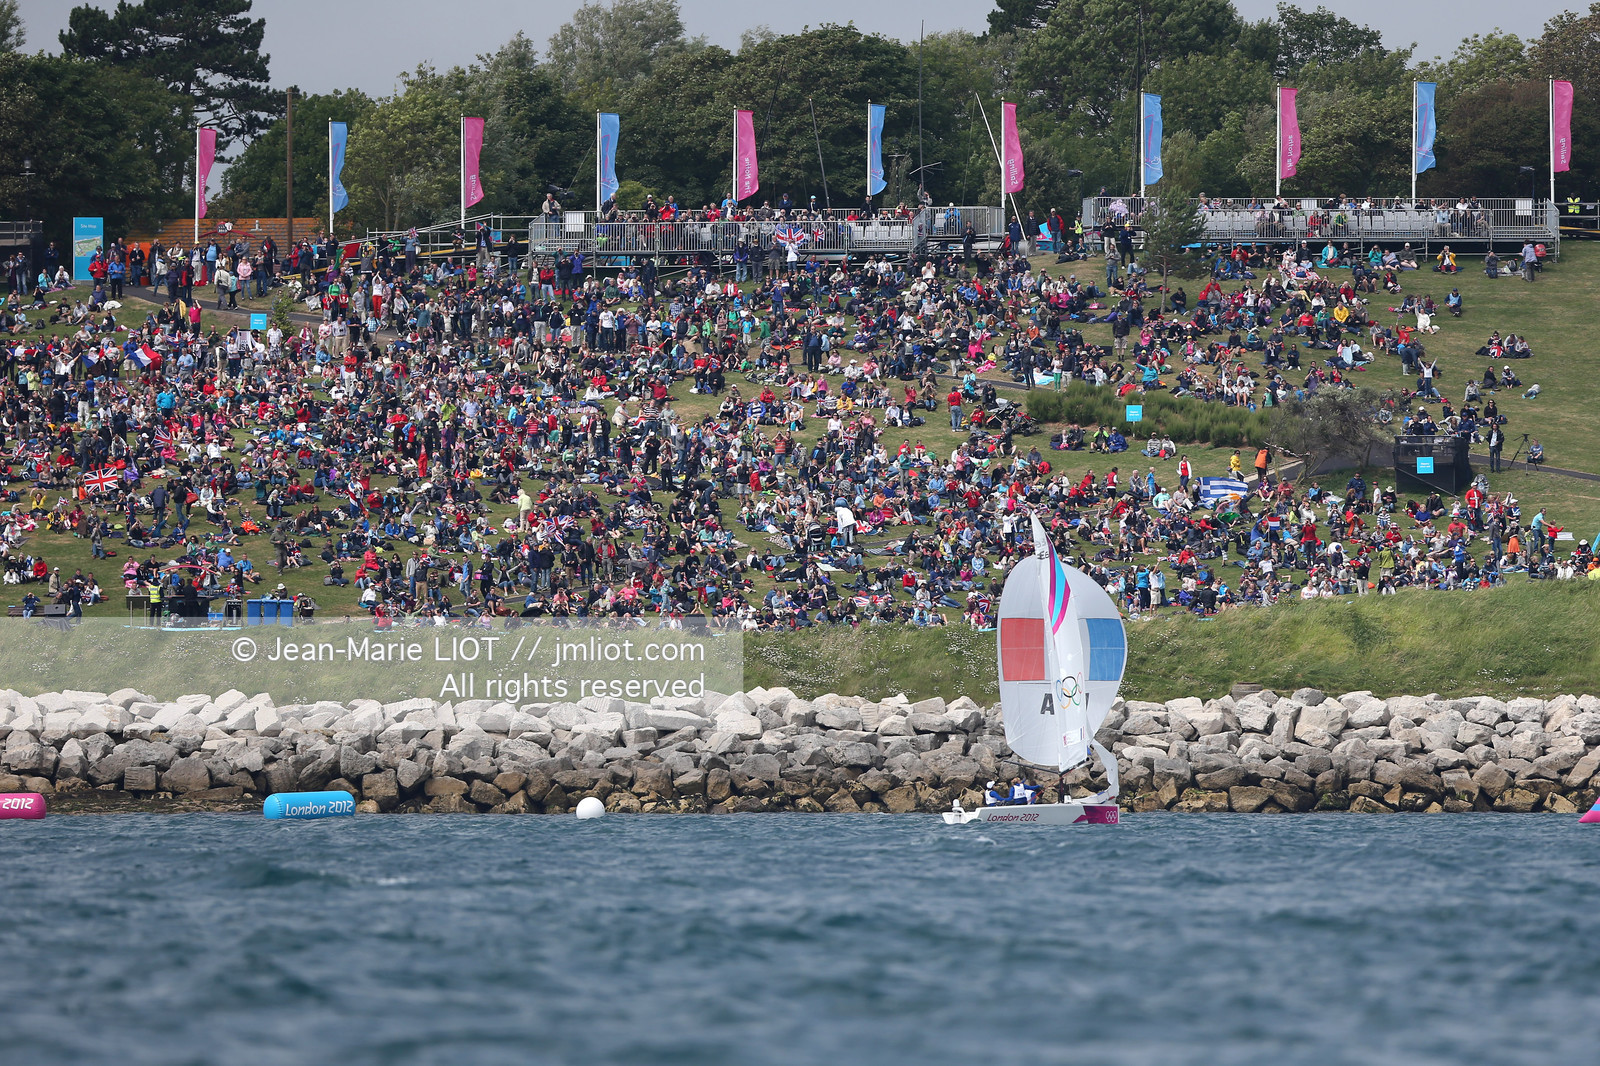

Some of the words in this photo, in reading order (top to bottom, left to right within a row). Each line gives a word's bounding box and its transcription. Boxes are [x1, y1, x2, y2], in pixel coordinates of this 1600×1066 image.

[2, 797, 35, 810] 2012
[285, 801, 326, 816] London
[328, 800, 354, 814] 2012
[986, 812, 1020, 822] London
[1019, 812, 1040, 822] 2012
